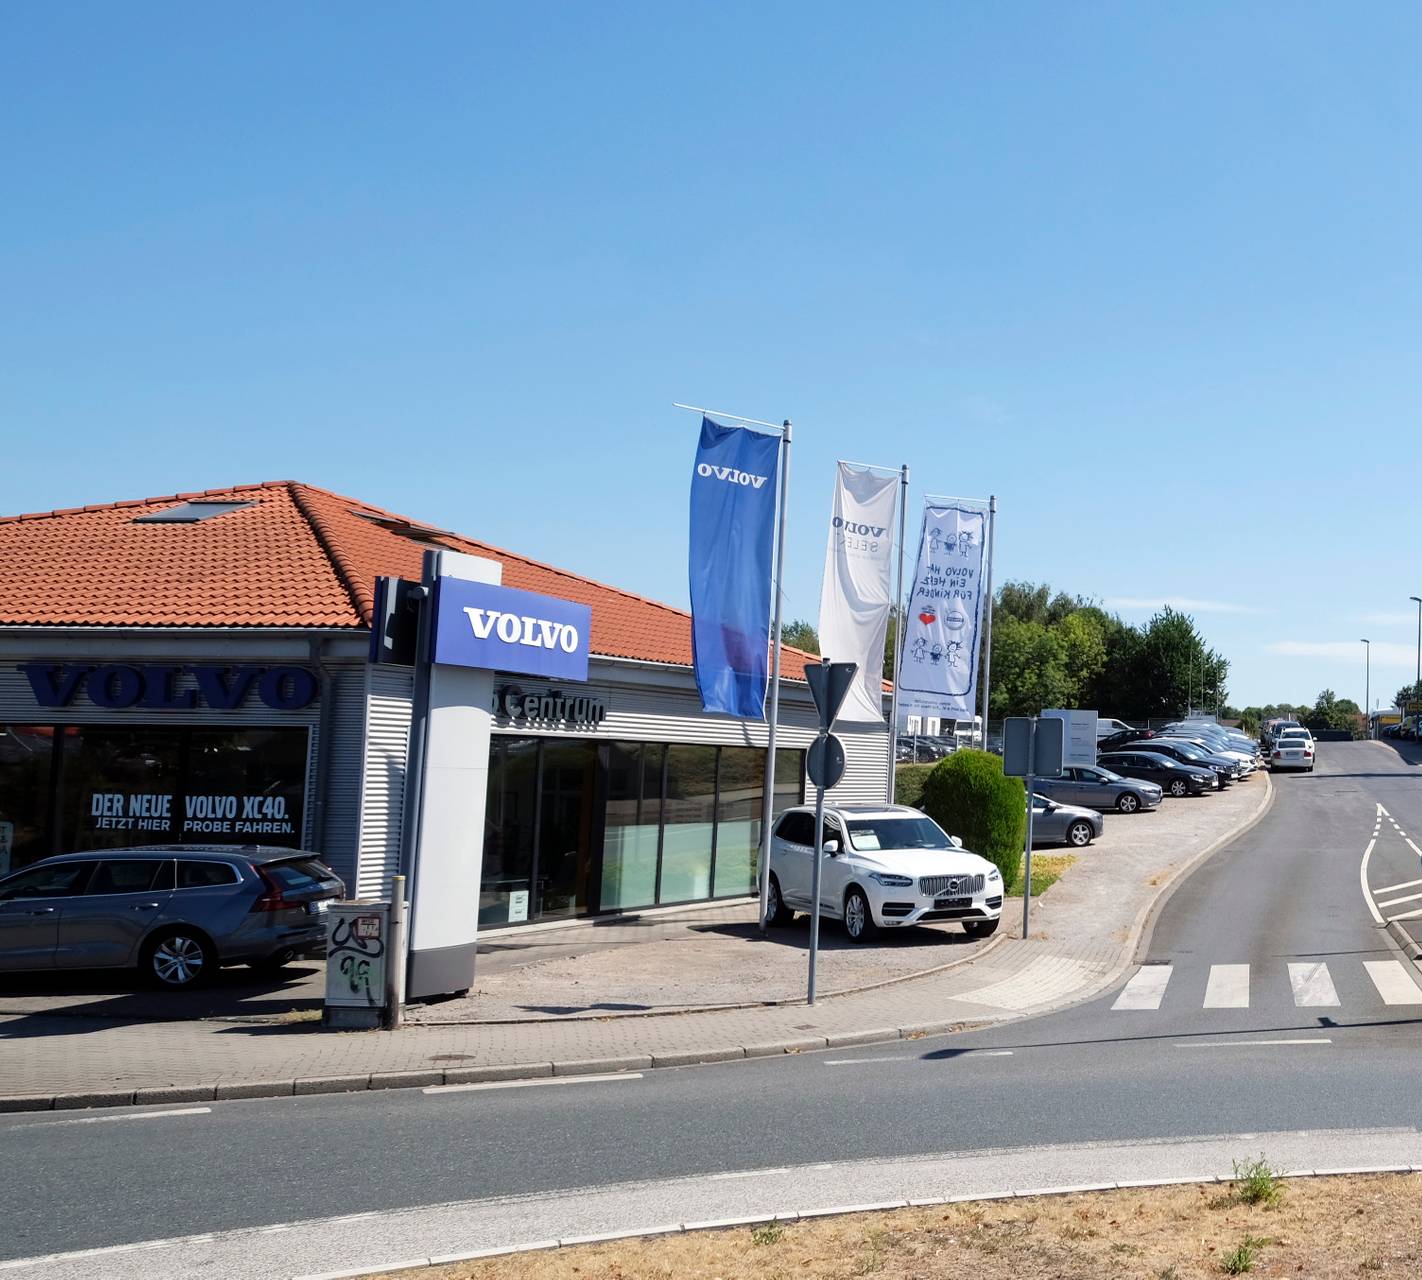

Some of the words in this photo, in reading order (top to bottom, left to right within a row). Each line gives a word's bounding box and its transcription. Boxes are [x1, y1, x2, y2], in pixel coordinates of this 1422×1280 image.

[463, 606, 579, 653] VOLVO
[17, 664, 318, 709] VOLVO
[505, 686, 606, 722] Centrum
[91, 793, 123, 817] DER
[129, 794, 173, 818] NEUE
[185, 796, 236, 819] VOLVO
[242, 797, 289, 819] XC40.
[96, 817, 134, 830] JETZT
[138, 819, 170, 831] HIER
[184, 820, 231, 833] PROBE
[235, 821, 295, 834] FAHREN.
